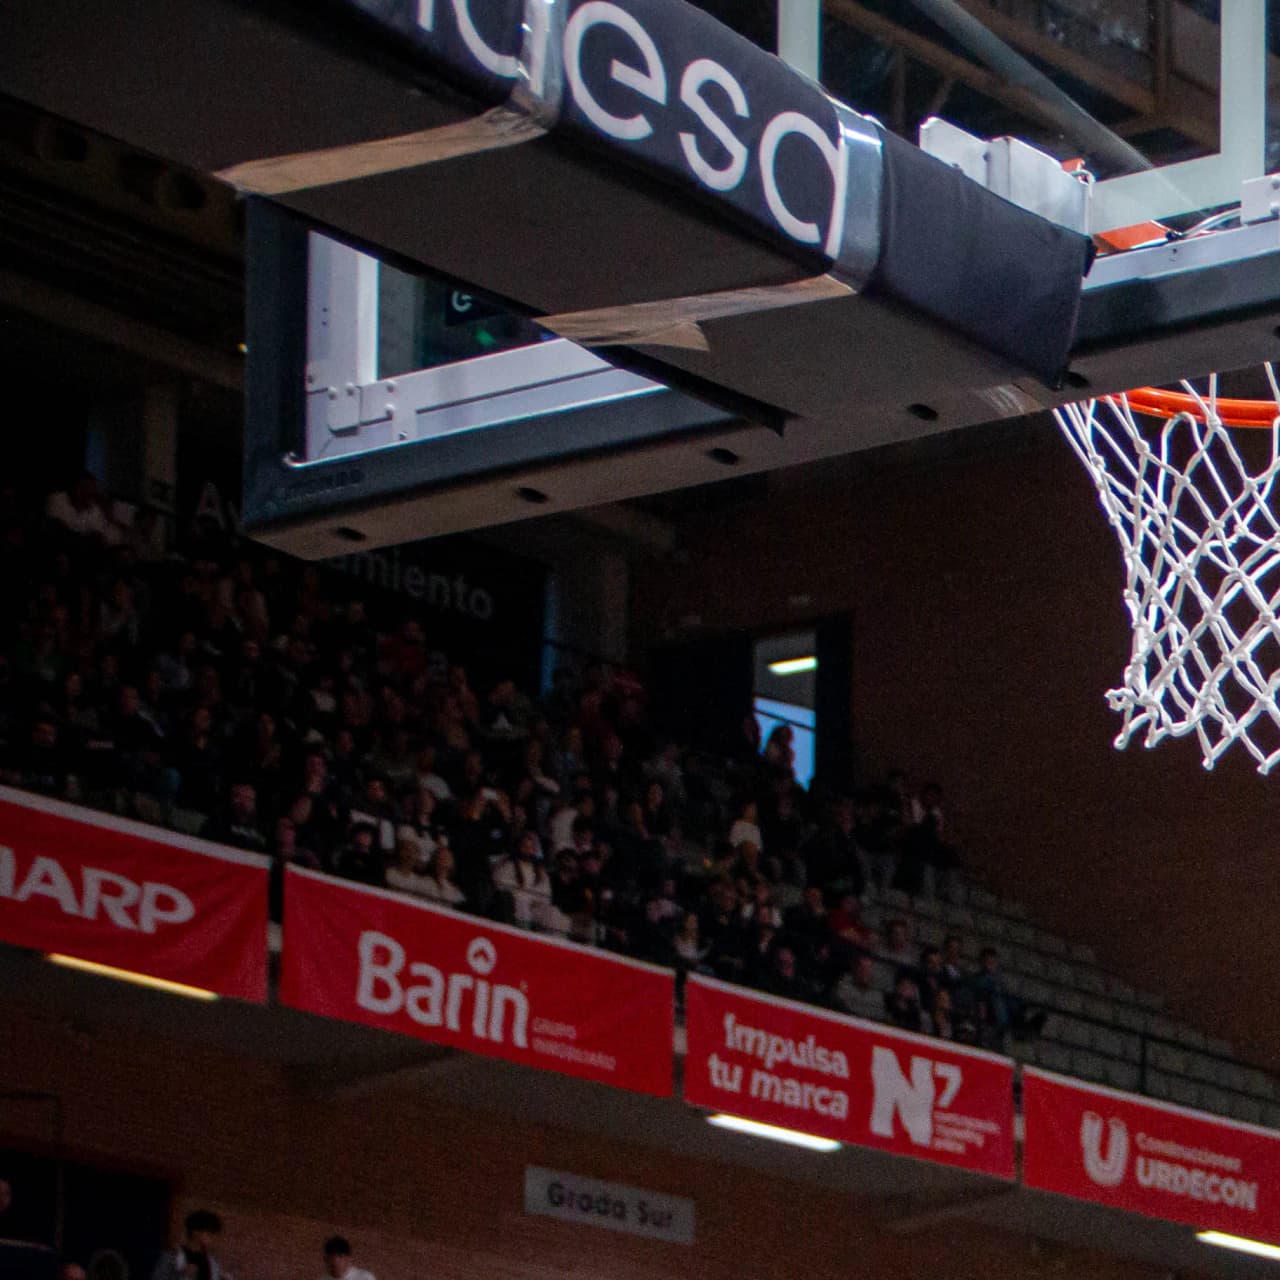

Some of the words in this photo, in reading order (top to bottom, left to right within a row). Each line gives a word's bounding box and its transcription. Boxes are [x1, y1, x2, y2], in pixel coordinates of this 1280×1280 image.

[0, 846, 195, 934] ARP
[357, 930, 530, 1048] Barin
[723, 1012, 850, 1079] Impulsa
[707, 1053, 743, 1094] tu
[750, 1069, 850, 1121] marca
[547, 1181, 627, 1221] Grada
[637, 1200, 674, 1228] Sur
[1136, 1156, 1258, 1212] URDECON
